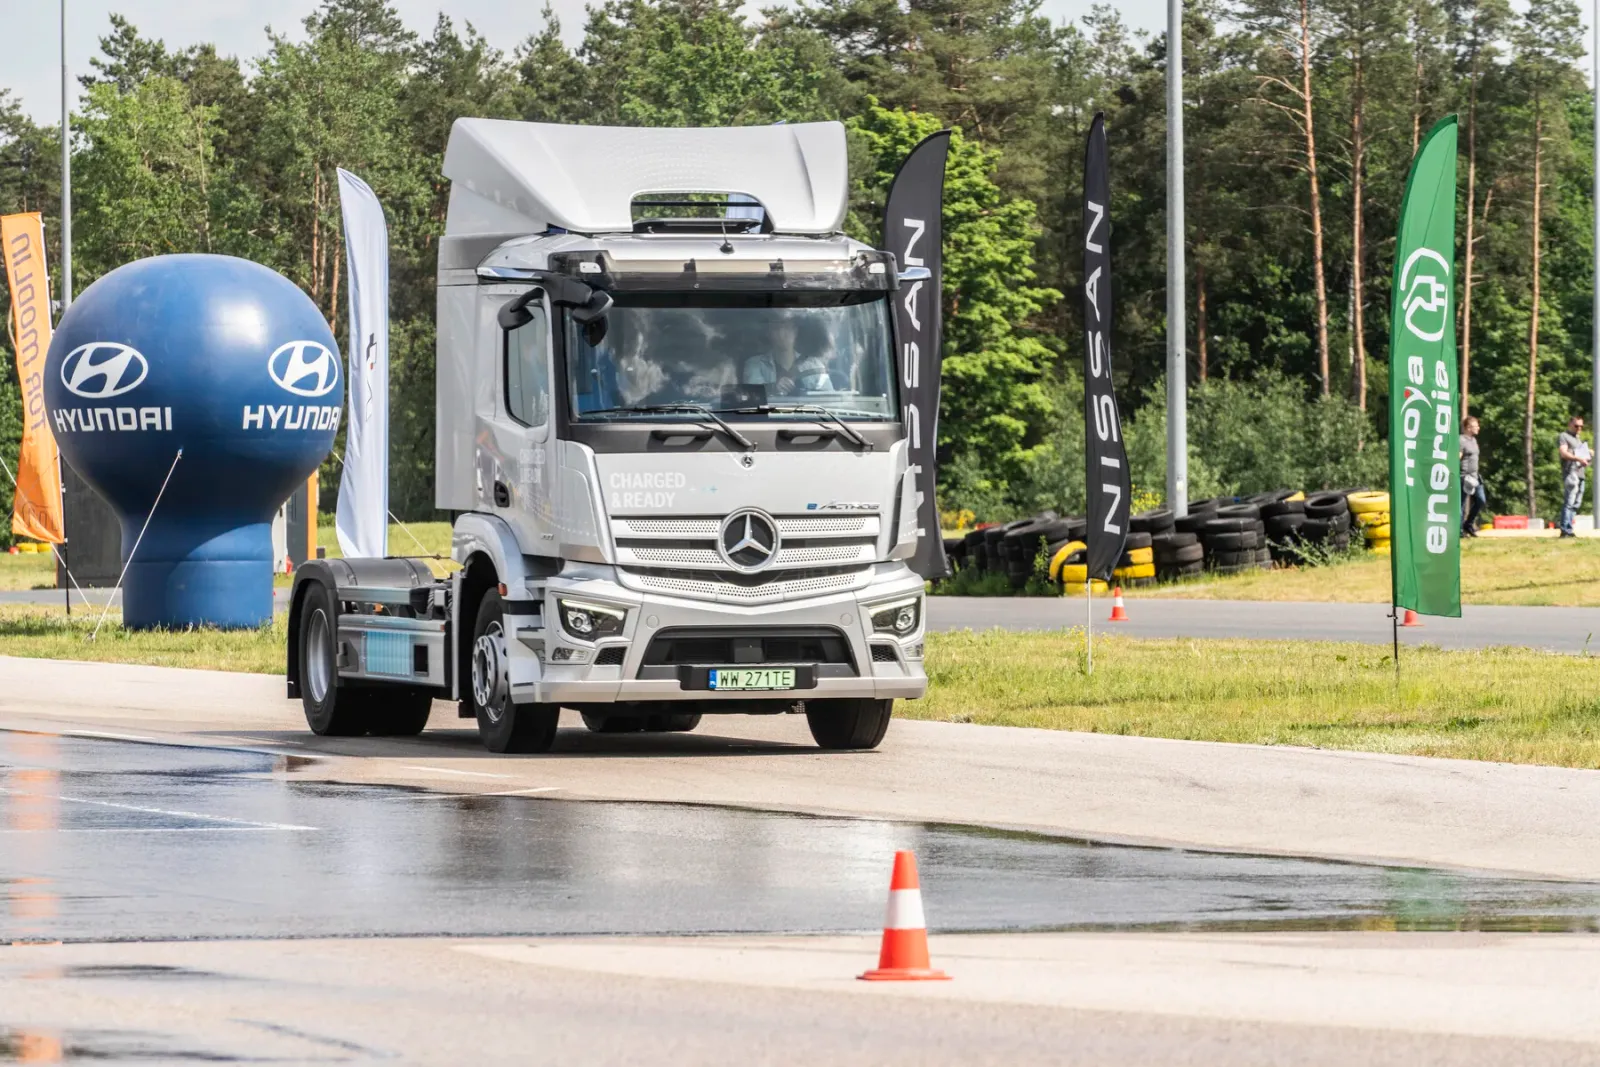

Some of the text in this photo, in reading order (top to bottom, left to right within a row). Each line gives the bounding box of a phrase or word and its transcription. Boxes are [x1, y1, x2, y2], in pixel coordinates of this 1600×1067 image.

[1085, 200, 1121, 536] NISSAN
[53, 406, 173, 433] HYUNDAI
[1401, 355, 1433, 487] moya
[1426, 360, 1452, 554] energia
[610, 472, 686, 489] CHARGED
[720, 671, 740, 686] WW
[745, 671, 791, 686] 271TE
